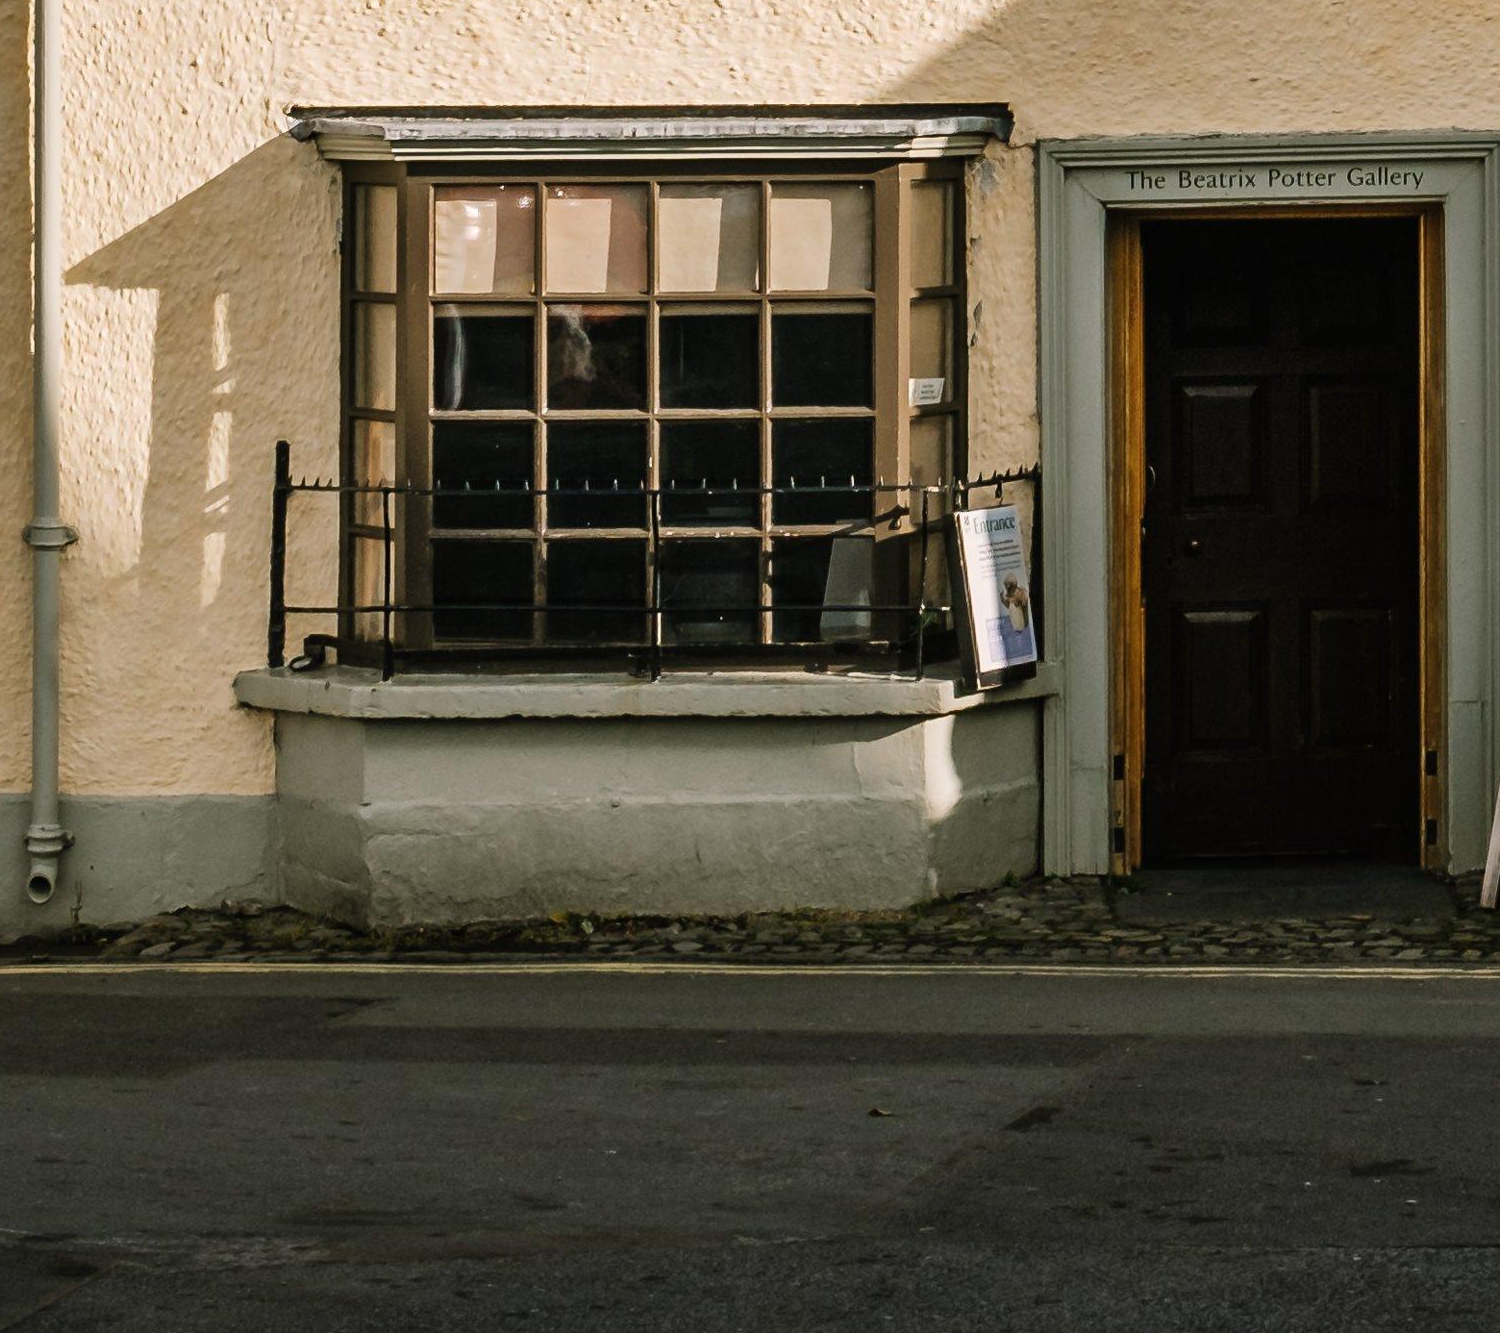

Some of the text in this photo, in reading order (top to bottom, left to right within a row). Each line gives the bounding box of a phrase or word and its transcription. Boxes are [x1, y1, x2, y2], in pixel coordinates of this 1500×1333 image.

[1125, 166, 1424, 191] The Beatrix Potter Gallery
[973, 516, 1016, 534] Entrance
